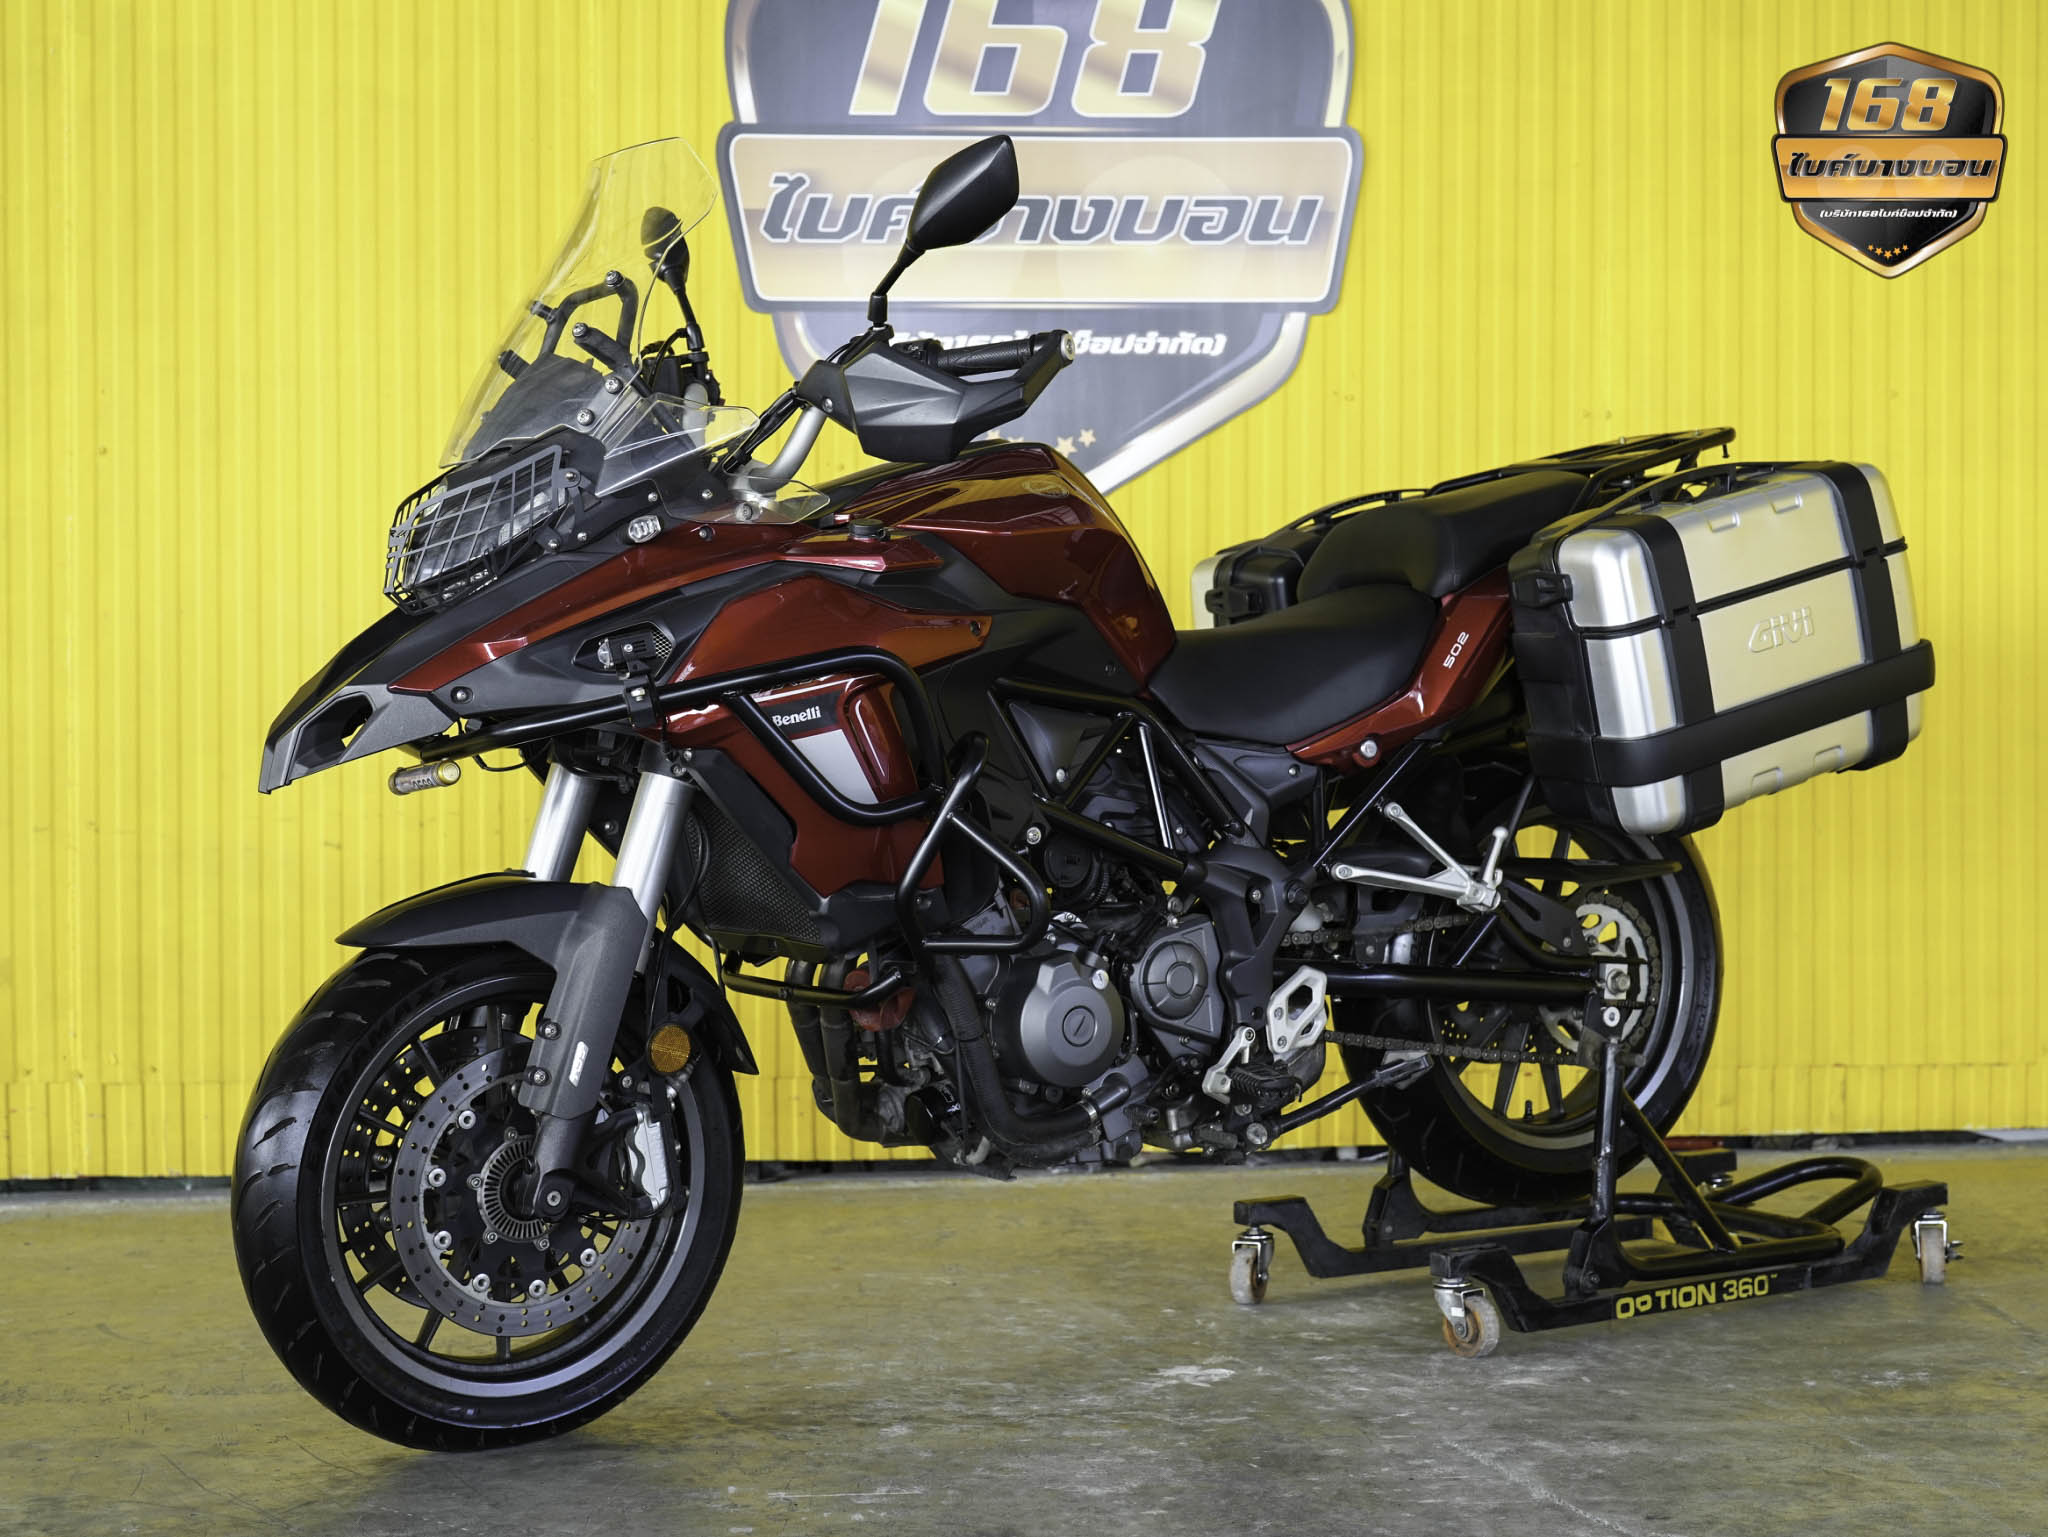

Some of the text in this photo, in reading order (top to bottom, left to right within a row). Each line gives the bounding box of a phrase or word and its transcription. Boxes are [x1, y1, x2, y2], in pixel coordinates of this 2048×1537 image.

[848, 0, 1221, 118] 168
[1442, 631, 1470, 669] 502
[771, 705, 822, 727] Benelli
